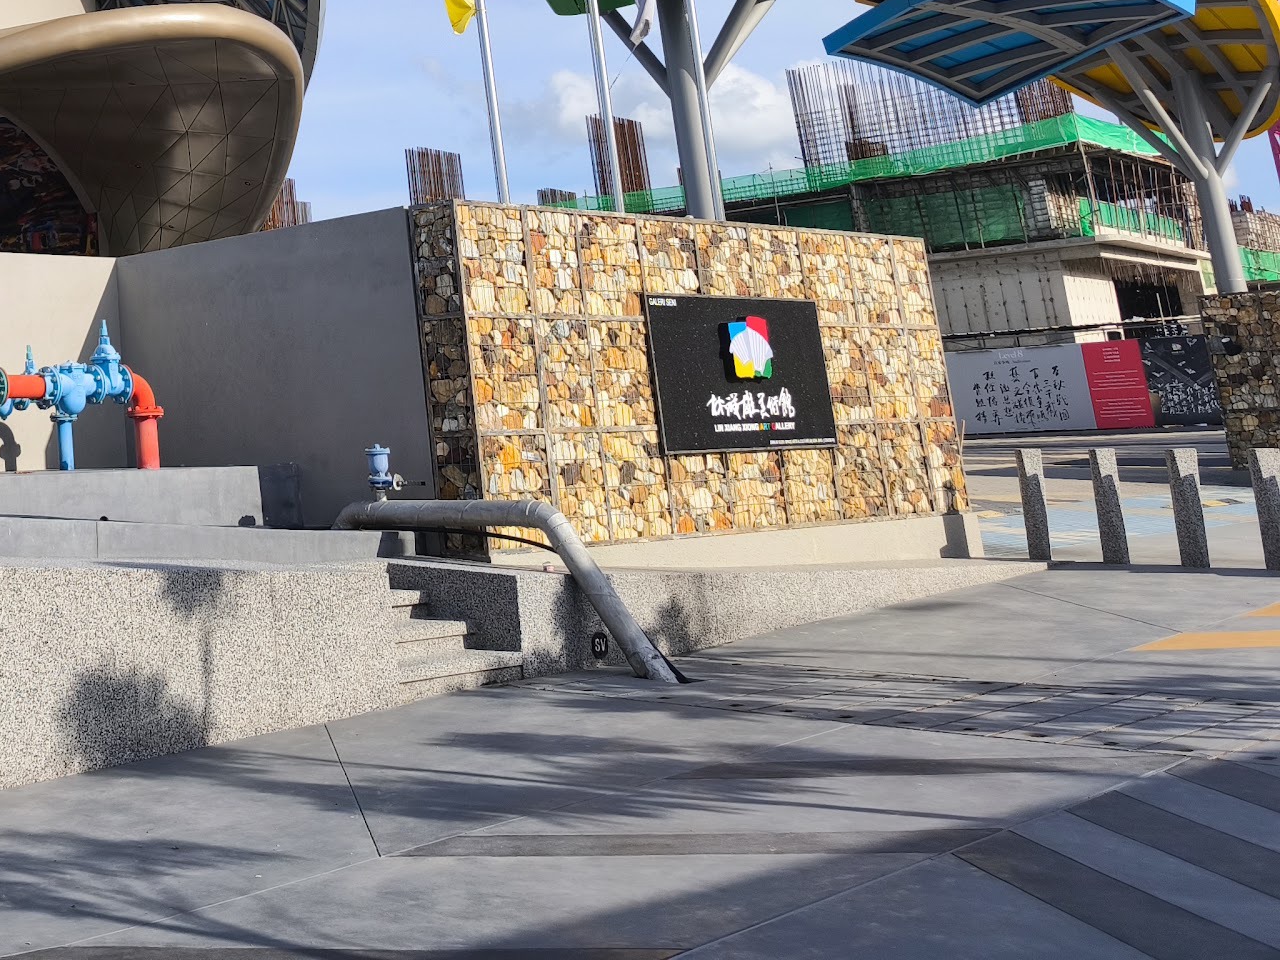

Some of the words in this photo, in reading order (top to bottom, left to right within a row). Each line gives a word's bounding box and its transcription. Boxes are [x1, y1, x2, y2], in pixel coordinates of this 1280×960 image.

[760, 422, 770, 431] ART
[771, 421, 796, 431] GALLERY
[595, 638, 606, 652] SV
